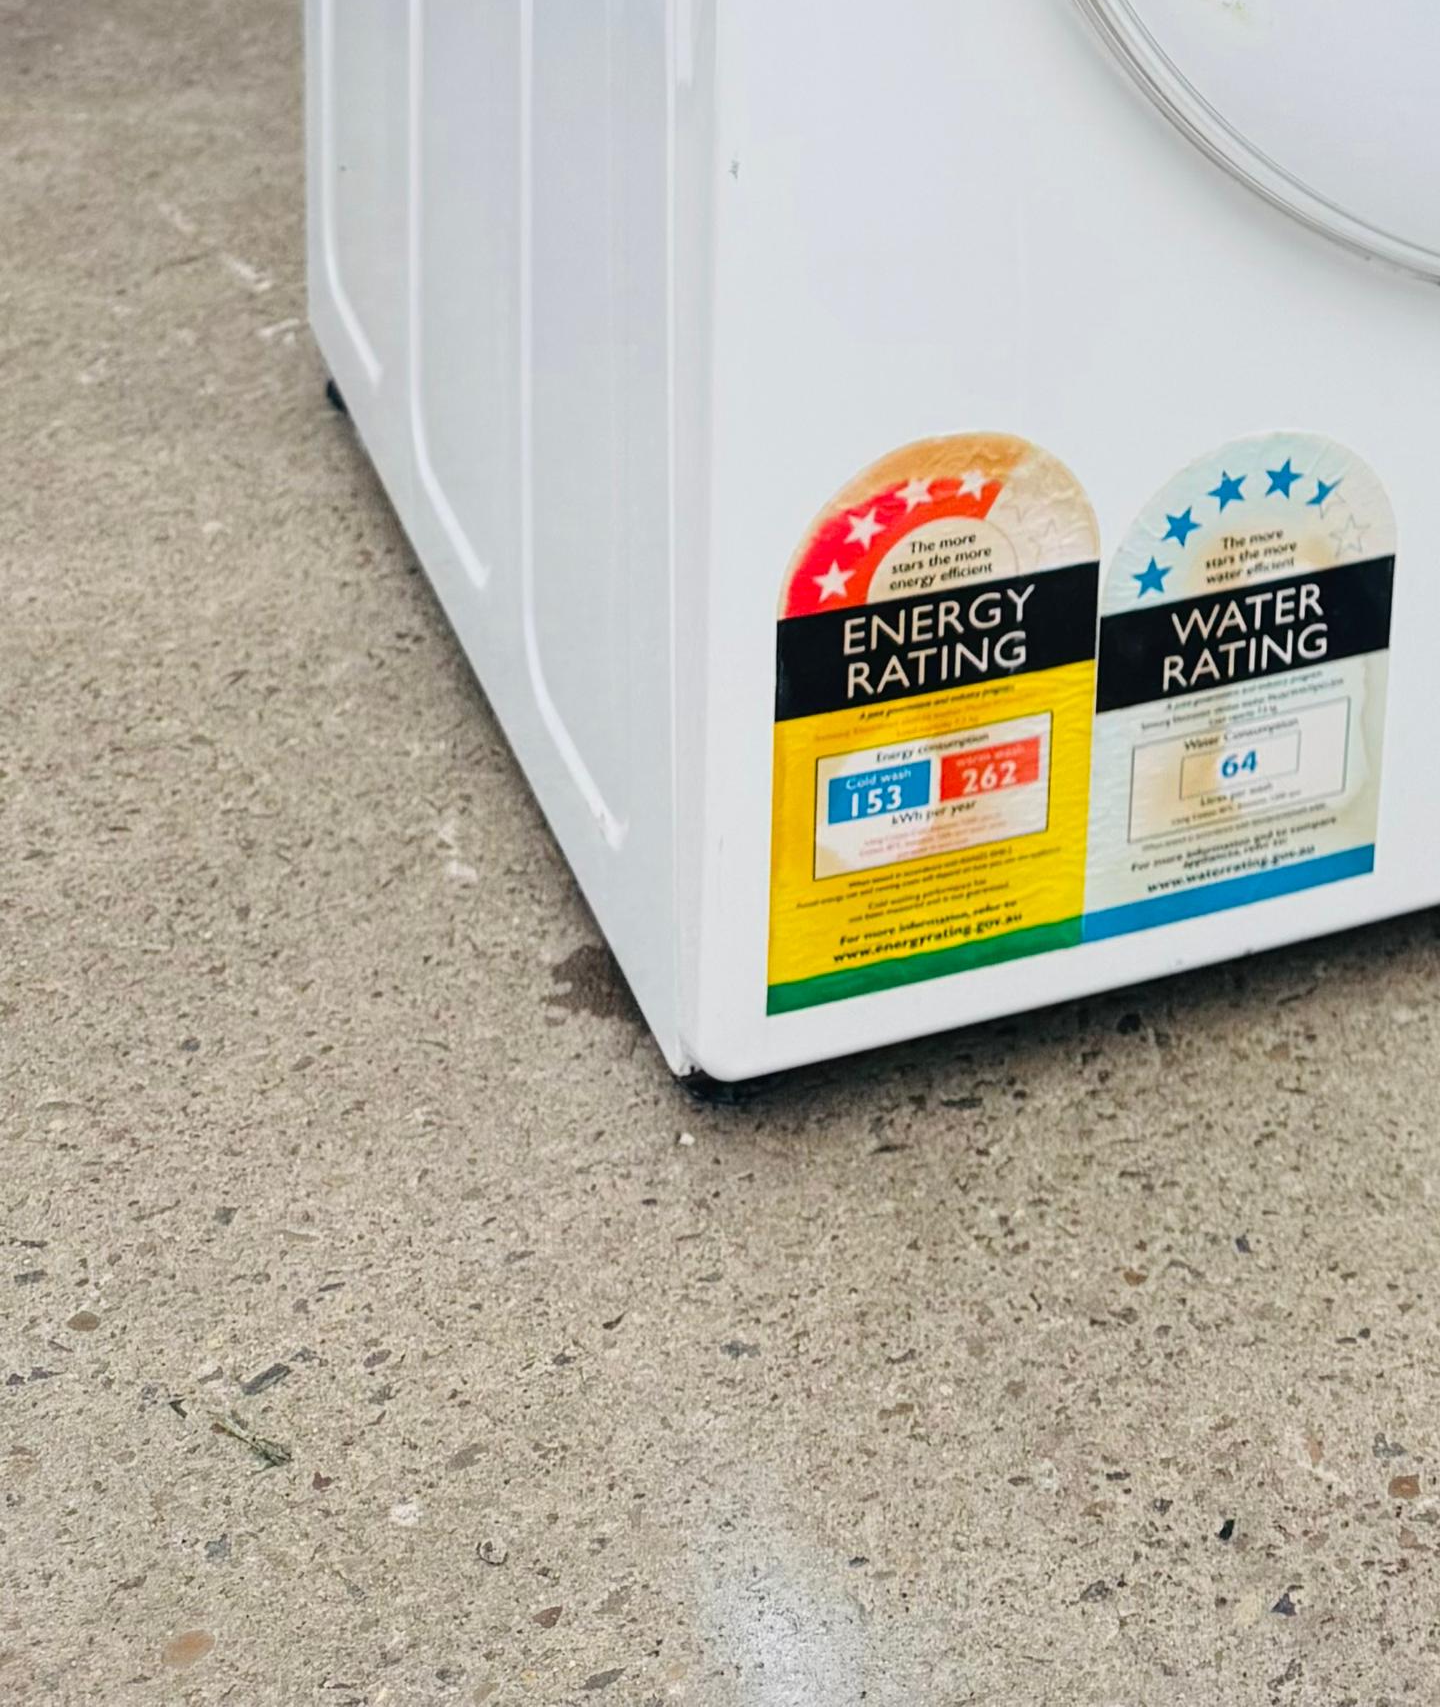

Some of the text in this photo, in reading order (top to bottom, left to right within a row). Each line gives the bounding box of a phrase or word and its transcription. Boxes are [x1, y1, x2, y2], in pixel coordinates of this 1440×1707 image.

[910, 534, 976, 554] The more
[1222, 530, 1284, 550] The more
[1239, 549, 1260, 563] the
[1263, 541, 1297, 557] more
[892, 547, 992, 575] stars the more
[889, 563, 993, 592] energy efficient
[843, 584, 1035, 657] ENERGY
[1171, 583, 1325, 646] WATER
[847, 630, 1028, 699] RATING
[1162, 623, 1329, 693] RATING
[876, 747, 914, 764] Energy
[1221, 749, 1257, 779] 64
[846, 768, 912, 792] Cold wash
[962, 760, 1017, 796] 262
[851, 785, 902, 819] 153
[833, 913, 1023, 963] www.energyrating.gov.au
